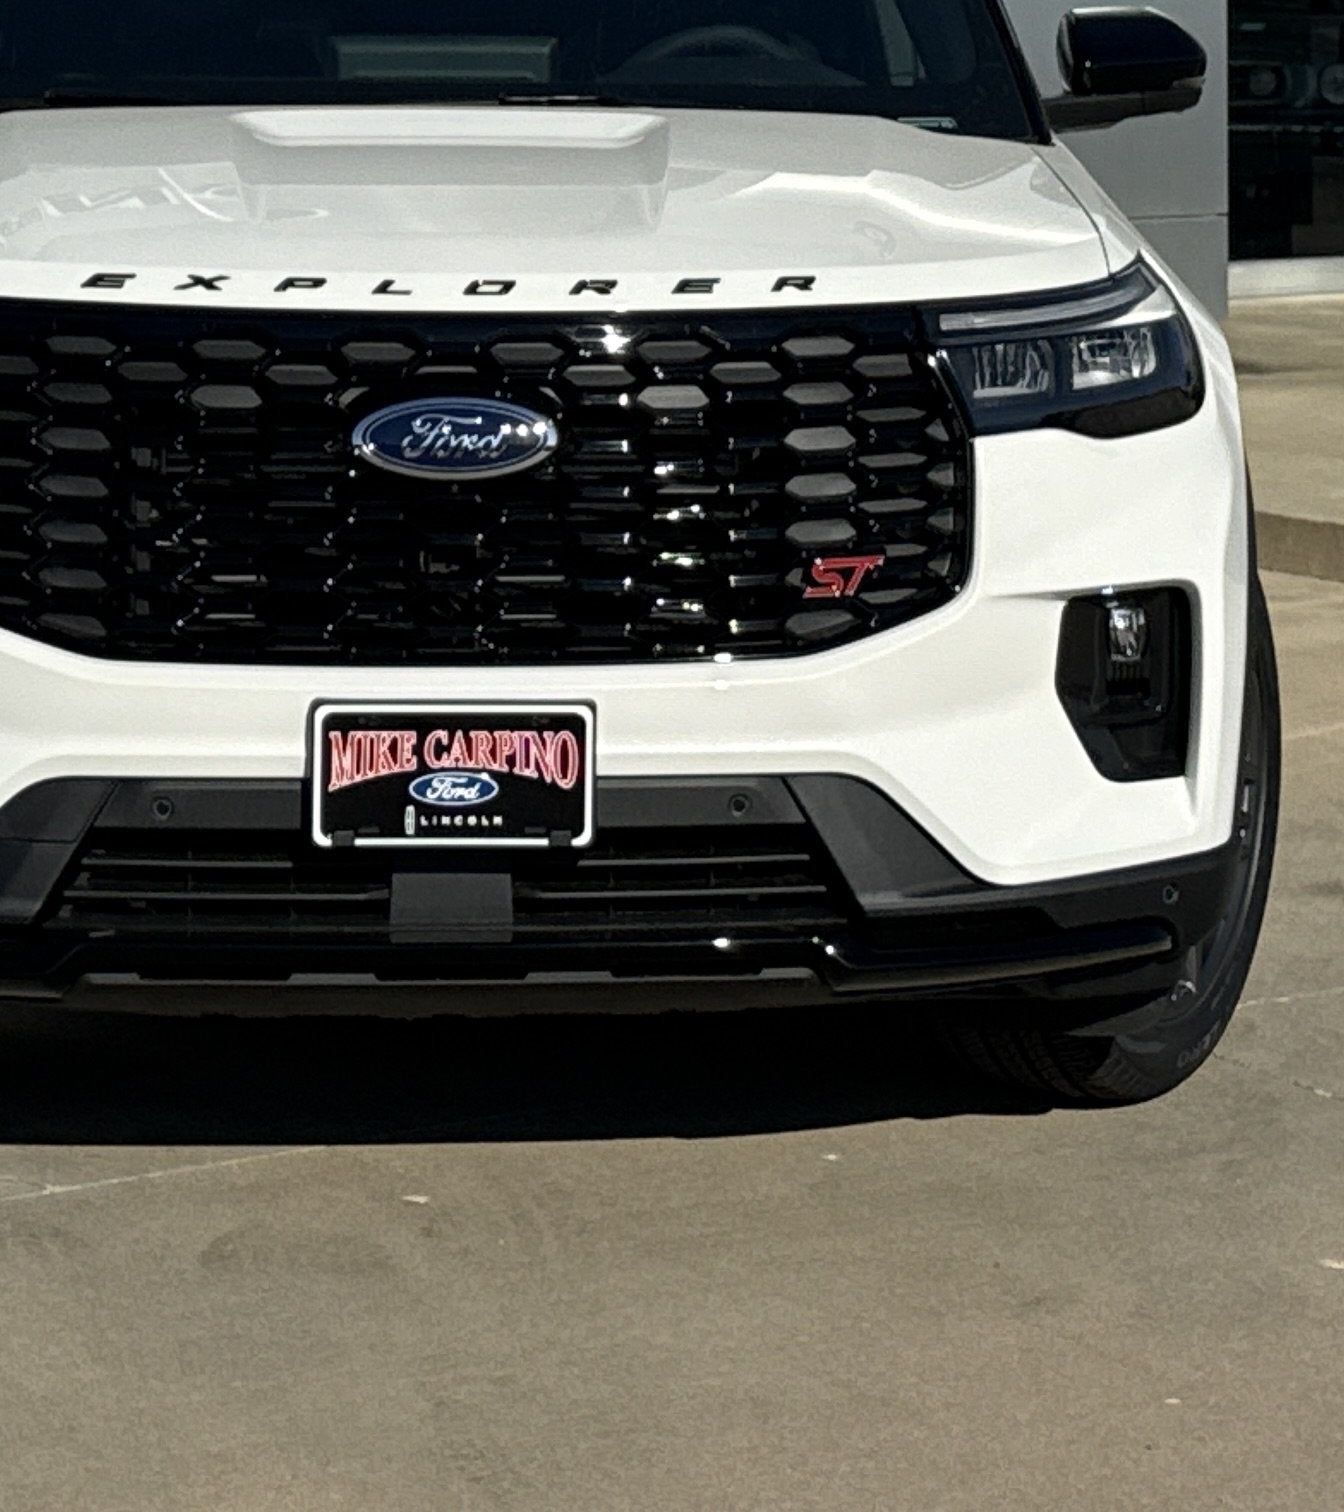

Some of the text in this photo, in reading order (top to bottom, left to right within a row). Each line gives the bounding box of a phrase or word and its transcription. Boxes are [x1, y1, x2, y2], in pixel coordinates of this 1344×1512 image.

[79, 272, 817, 296] EXPLORER
[401, 412, 512, 459] Ford
[802, 554, 886, 600] ST
[327, 729, 579, 793] MIKE CARPINO
[425, 776, 483, 800] Ford
[419, 814, 504, 827] LINCOLN
